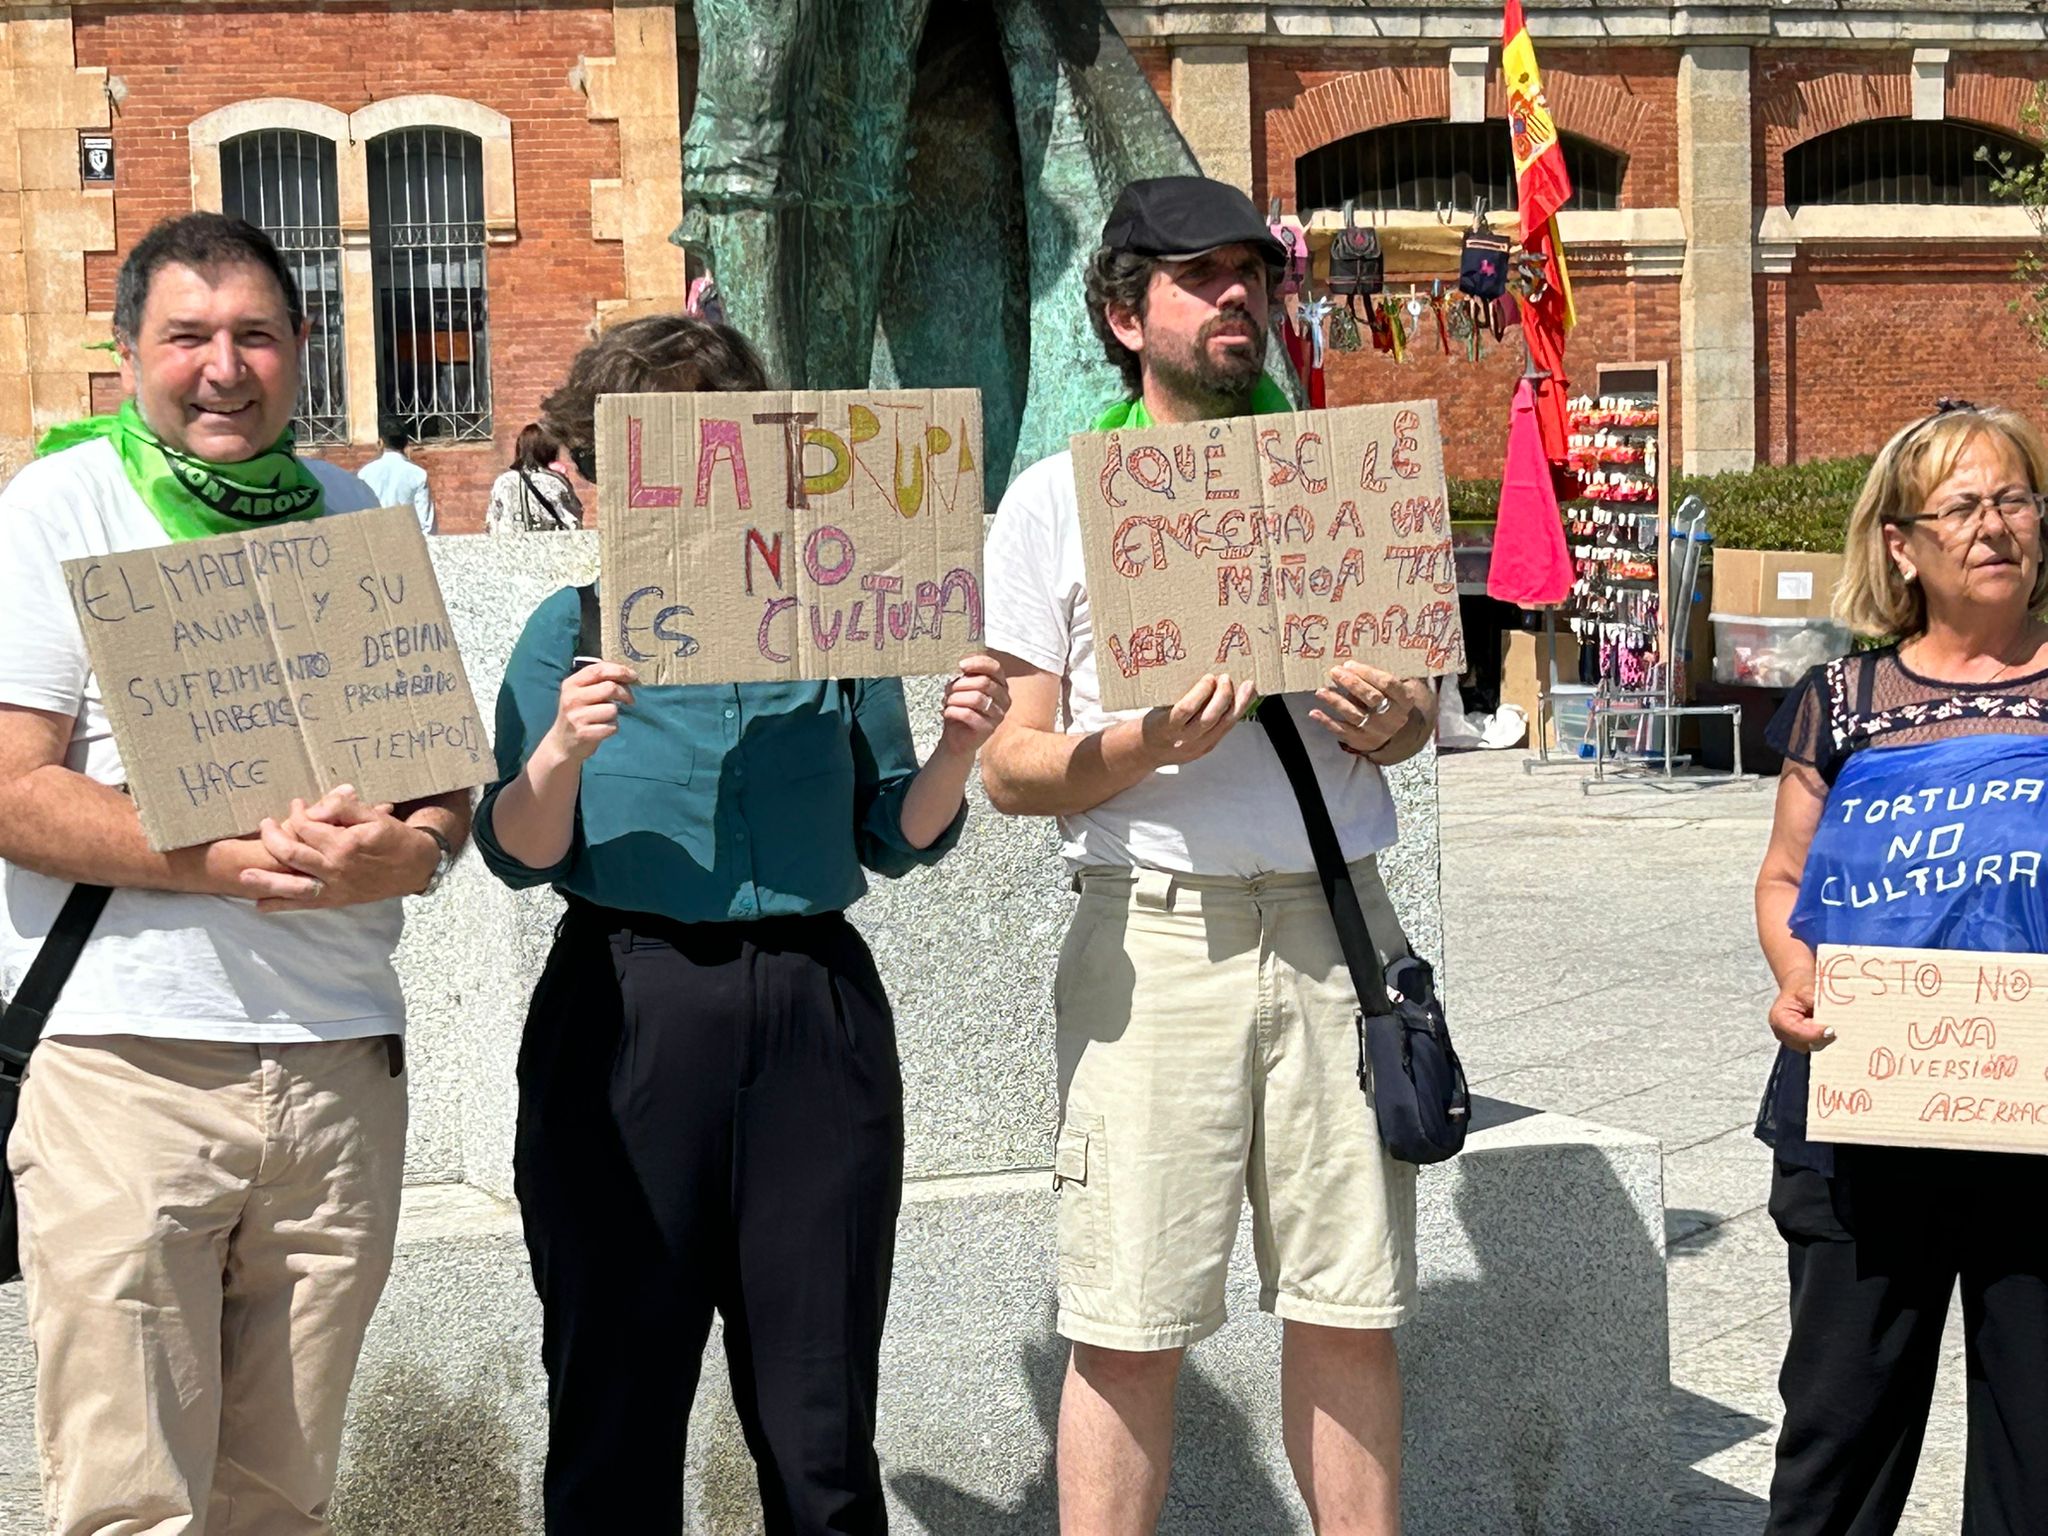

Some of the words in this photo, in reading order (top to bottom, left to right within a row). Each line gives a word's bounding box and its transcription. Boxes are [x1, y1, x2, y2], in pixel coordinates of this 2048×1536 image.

[628, 414, 752, 511] LA
[1259, 429, 1328, 494] SE
[1360, 410, 1422, 493] LE
[1327, 500, 1365, 541] A
[745, 526, 855, 598] NO
[81, 565, 155, 623] EL
[312, 591, 331, 624] Y
[358, 574, 406, 613] SU
[620, 586, 700, 662] ES
[757, 567, 985, 663] CULTURA
[128, 651, 332, 717] SUFRIMIENTO
[189, 692, 320, 743] HABERSE
[177, 759, 270, 807] HACE
[1841, 778, 2046, 824] TORTURA
[1887, 822, 1964, 862] NO
[1820, 850, 2041, 909] CULTURA
[1817, 953, 1942, 1007] ESTO
[1975, 967, 2031, 1004] NO
[1908, 1016, 1996, 1051] UNA
[1817, 1084, 1872, 1119] UNA
